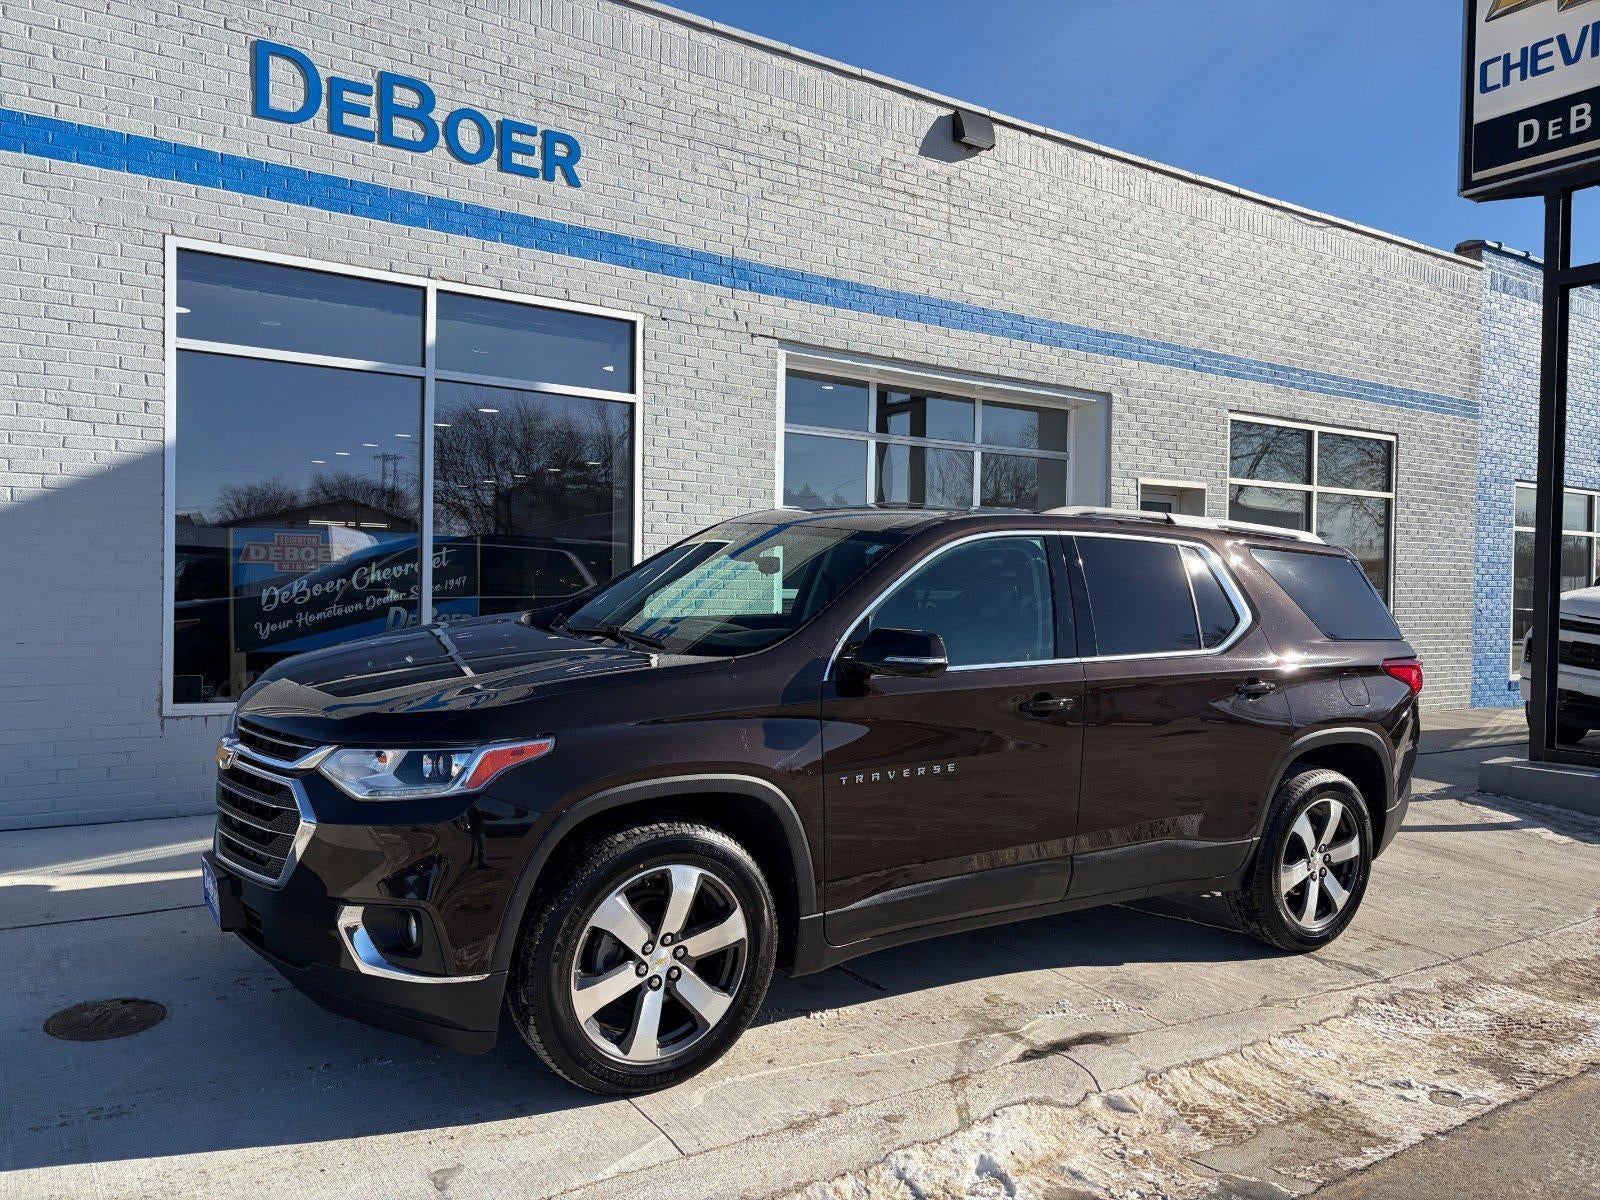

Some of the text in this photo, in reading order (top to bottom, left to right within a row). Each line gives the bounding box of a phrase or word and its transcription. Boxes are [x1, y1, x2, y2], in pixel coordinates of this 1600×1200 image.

[249, 545, 331, 562] DEBOE
[261, 546, 458, 612] DeBoer Chevroet
[254, 618, 293, 640] Your
[296, 602, 363, 627] Hometown
[365, 589, 407, 611] Dealer
[445, 575, 467, 591] 1947
[839, 763, 955, 786] TRAVERSE
